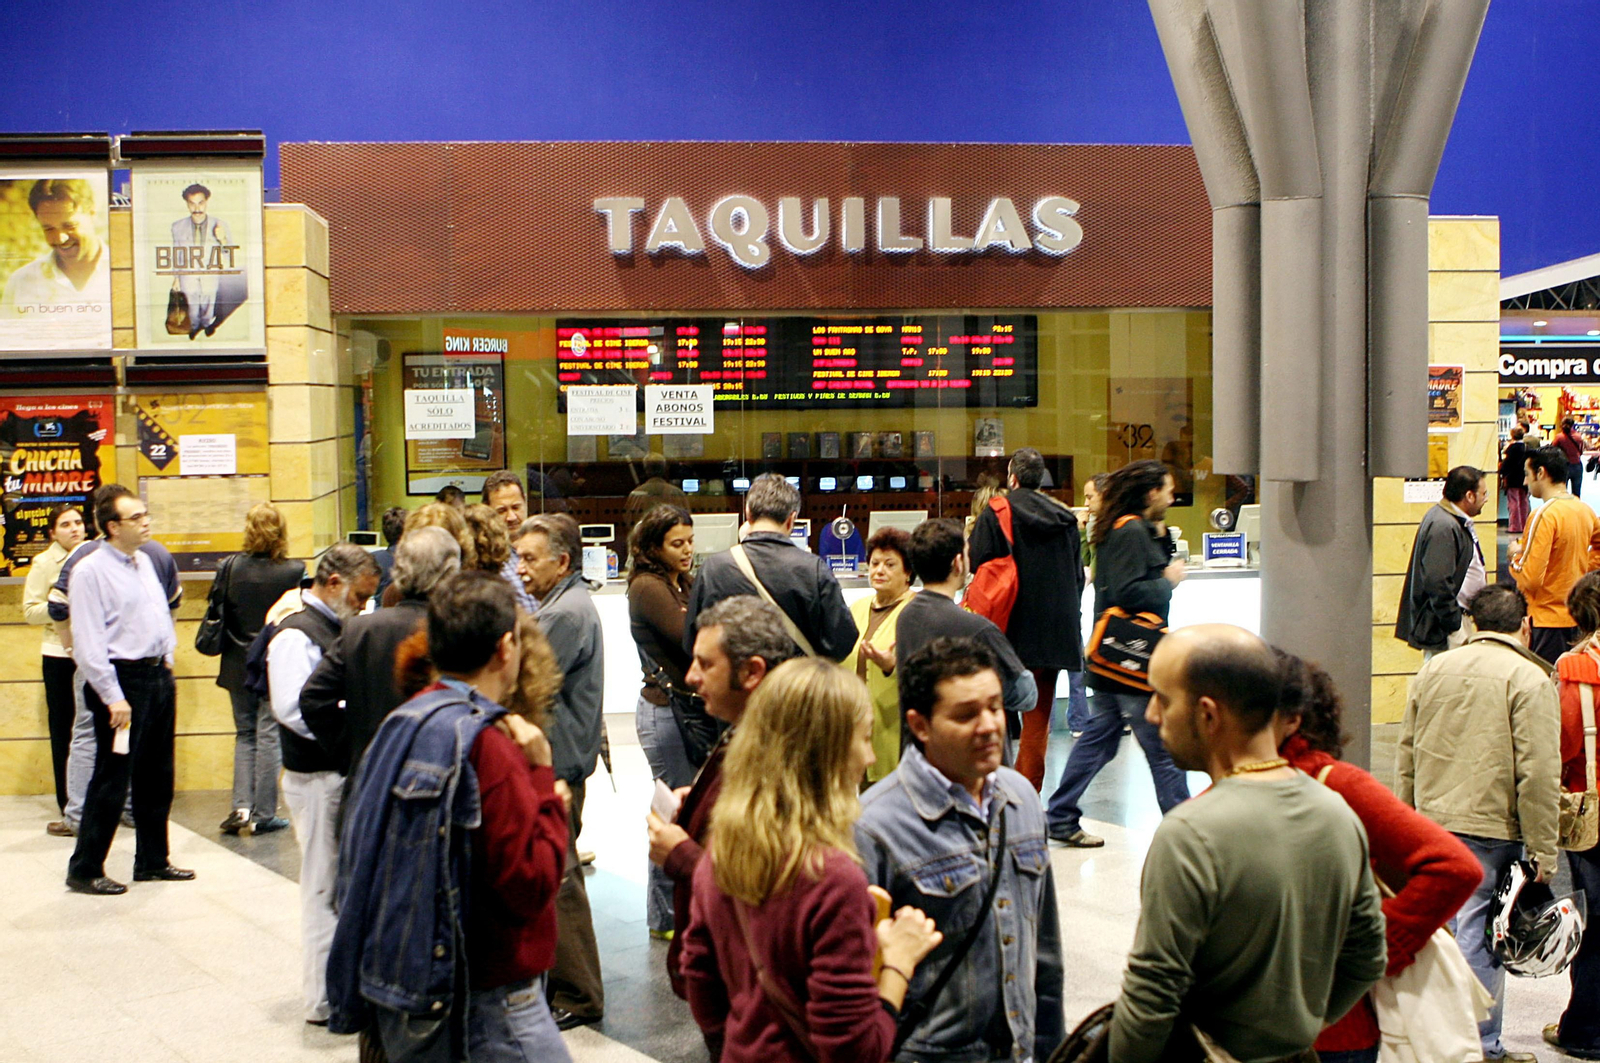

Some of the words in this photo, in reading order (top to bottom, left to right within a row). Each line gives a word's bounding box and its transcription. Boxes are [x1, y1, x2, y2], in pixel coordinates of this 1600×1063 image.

[593, 195, 1084, 269] TAQUILLAS
[18, 305, 34, 313] un
[39, 303, 72, 313] buen
[77, 302, 102, 313] año
[1498, 353, 1587, 379] Compra
[412, 367, 429, 378] TU
[432, 366, 495, 378] ENTRADA
[414, 394, 465, 403] TAQUILLA
[660, 390, 698, 399] VENTA
[427, 406, 453, 415] SÓLO
[656, 403, 704, 412] ABONOS
[409, 421, 472, 430] ACREDITADOS
[652, 417, 707, 426] FESTIVAL
[150, 444, 167, 456] 22
[10, 448, 83, 475] CHICHA
[4, 475, 22, 492] tu
[22, 470, 95, 494] MADRE
